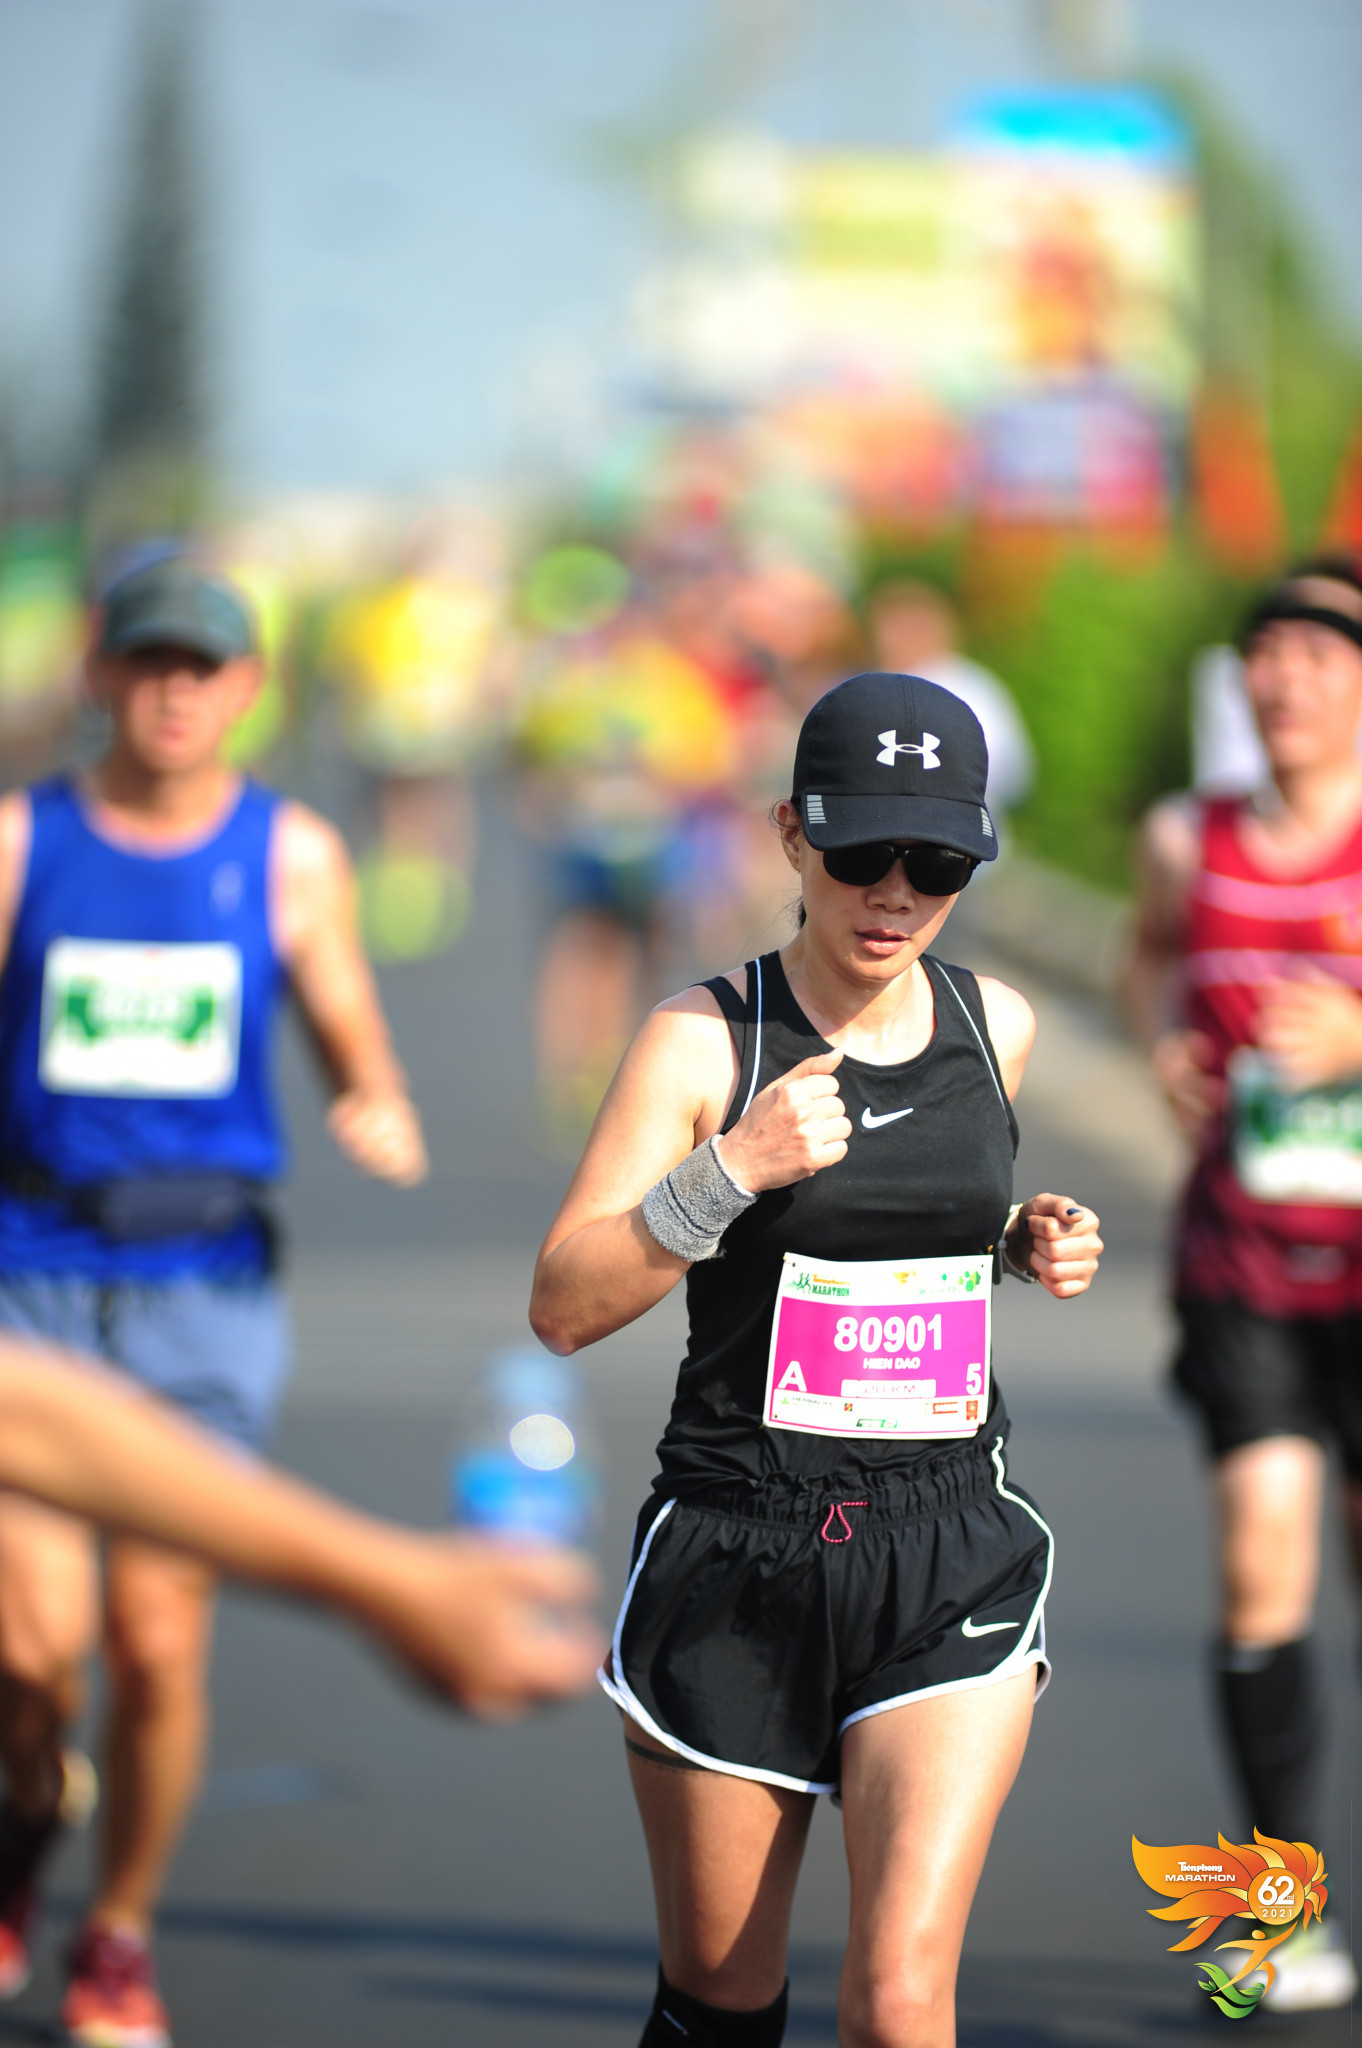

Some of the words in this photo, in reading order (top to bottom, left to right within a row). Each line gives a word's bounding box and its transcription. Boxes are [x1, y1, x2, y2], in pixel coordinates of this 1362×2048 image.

[833, 1313, 942, 1353] 80901
[777, 1360, 808, 1392] A
[894, 1357, 921, 1369] DAO
[966, 1363, 982, 1395] 5
